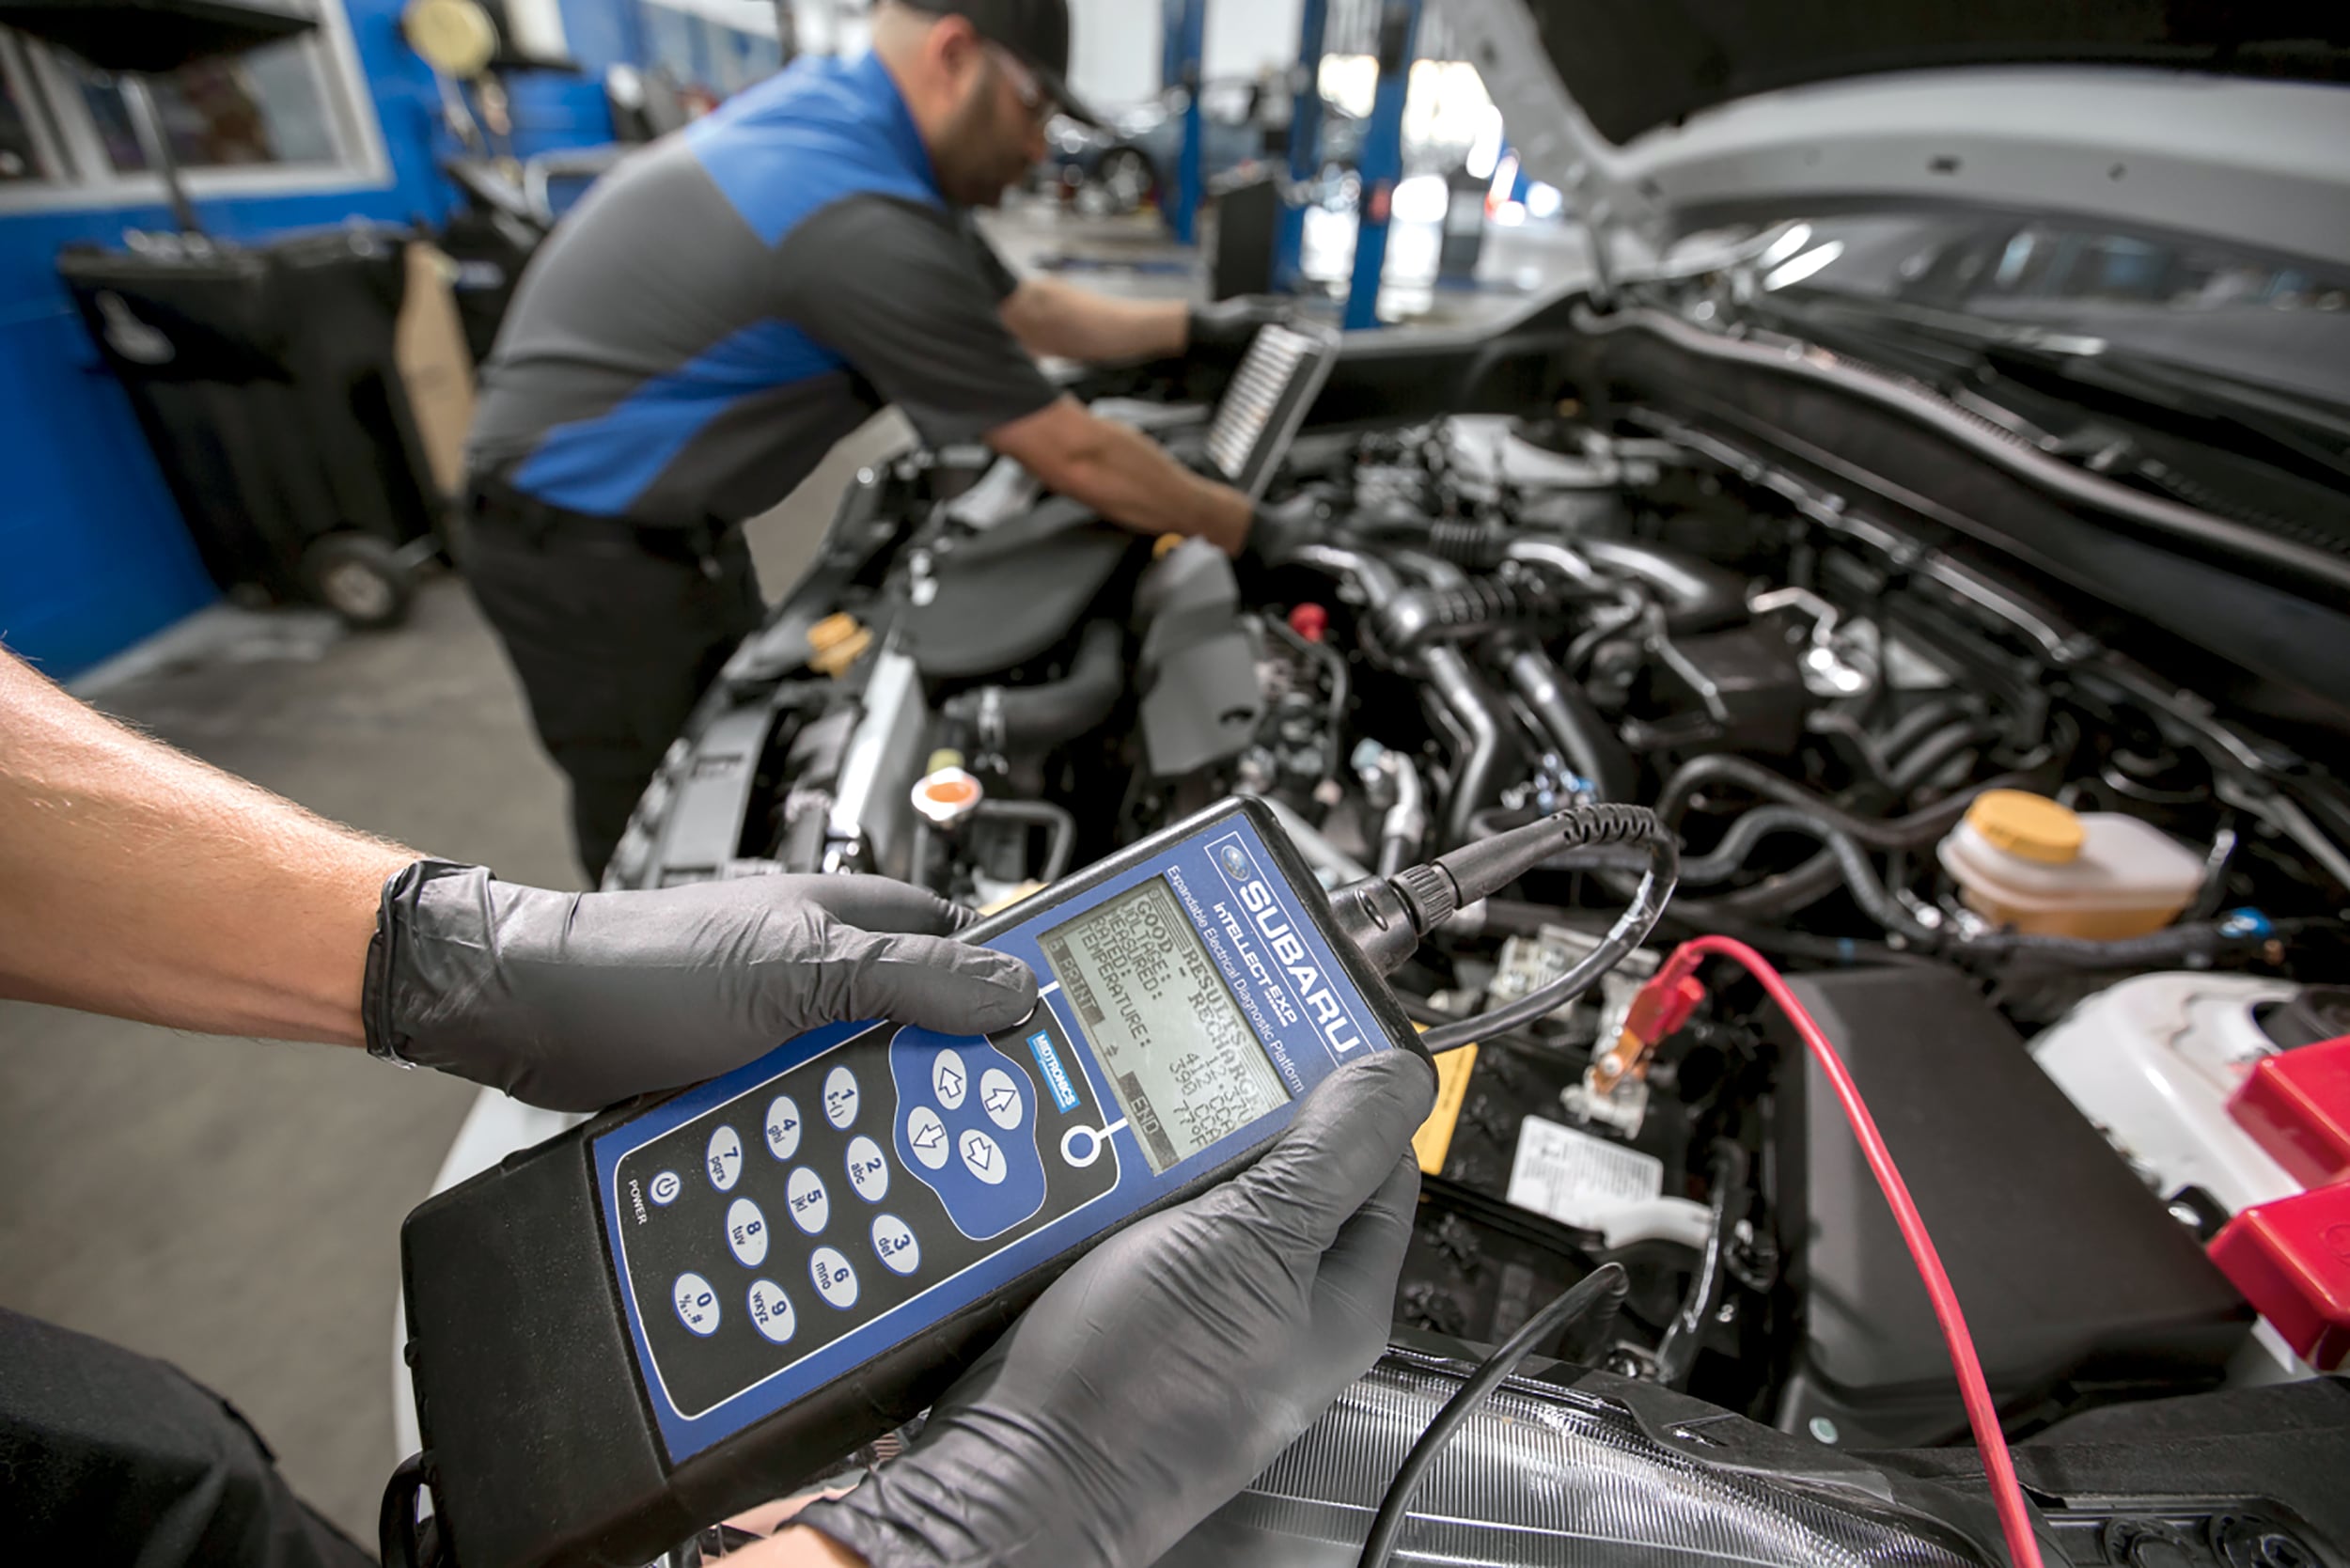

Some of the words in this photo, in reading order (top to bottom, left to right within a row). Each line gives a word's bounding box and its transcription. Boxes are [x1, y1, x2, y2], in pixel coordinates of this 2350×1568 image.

[1239, 880, 1360, 1053] SUBARU
[1075, 921, 1151, 1047] TEMPERATURE:
[1167, 865, 1208, 928] Expandable
[1202, 927, 1241, 979] Electrical
[1232, 978, 1274, 1041] Diagnostic
[1269, 1039, 1304, 1092] Platform
[1136, 900, 1173, 953] GOOD
[1186, 989, 1264, 1111] RECHARGE
[1182, 947, 1246, 1045] RESULTS
[1089, 914, 1131, 978] RATED:
[1168, 1058, 1197, 1096] 390
[1193, 1103, 1221, 1143] CCA
[1058, 957, 1096, 1014] PRINT
[1129, 1095, 1159, 1135] END
[1035, 1034, 1075, 1105] MIDTRONICS
[838, 1089, 854, 1100] 1
[1185, 1052, 1212, 1089] 412
[1208, 1094, 1236, 1135] CCA
[783, 1119, 796, 1131] 4
[723, 1146, 738, 1158] 7
[709, 1155, 727, 1183] pqrs
[850, 1162, 865, 1184] abc
[865, 1157, 881, 1173] 2
[628, 1179, 647, 1225] POWER
[790, 1195, 807, 1213] jkl
[807, 1189, 822, 1203] 5
[731, 1225, 744, 1245] tuv
[745, 1220, 760, 1235] 8
[878, 1237, 895, 1258] def
[893, 1233, 910, 1250] 3
[815, 1262, 831, 1290] mno
[833, 1267, 849, 1282] 6
[696, 1292, 712, 1308] 0
[751, 1291, 769, 1325] wxyz
[771, 1300, 786, 1316] 9
